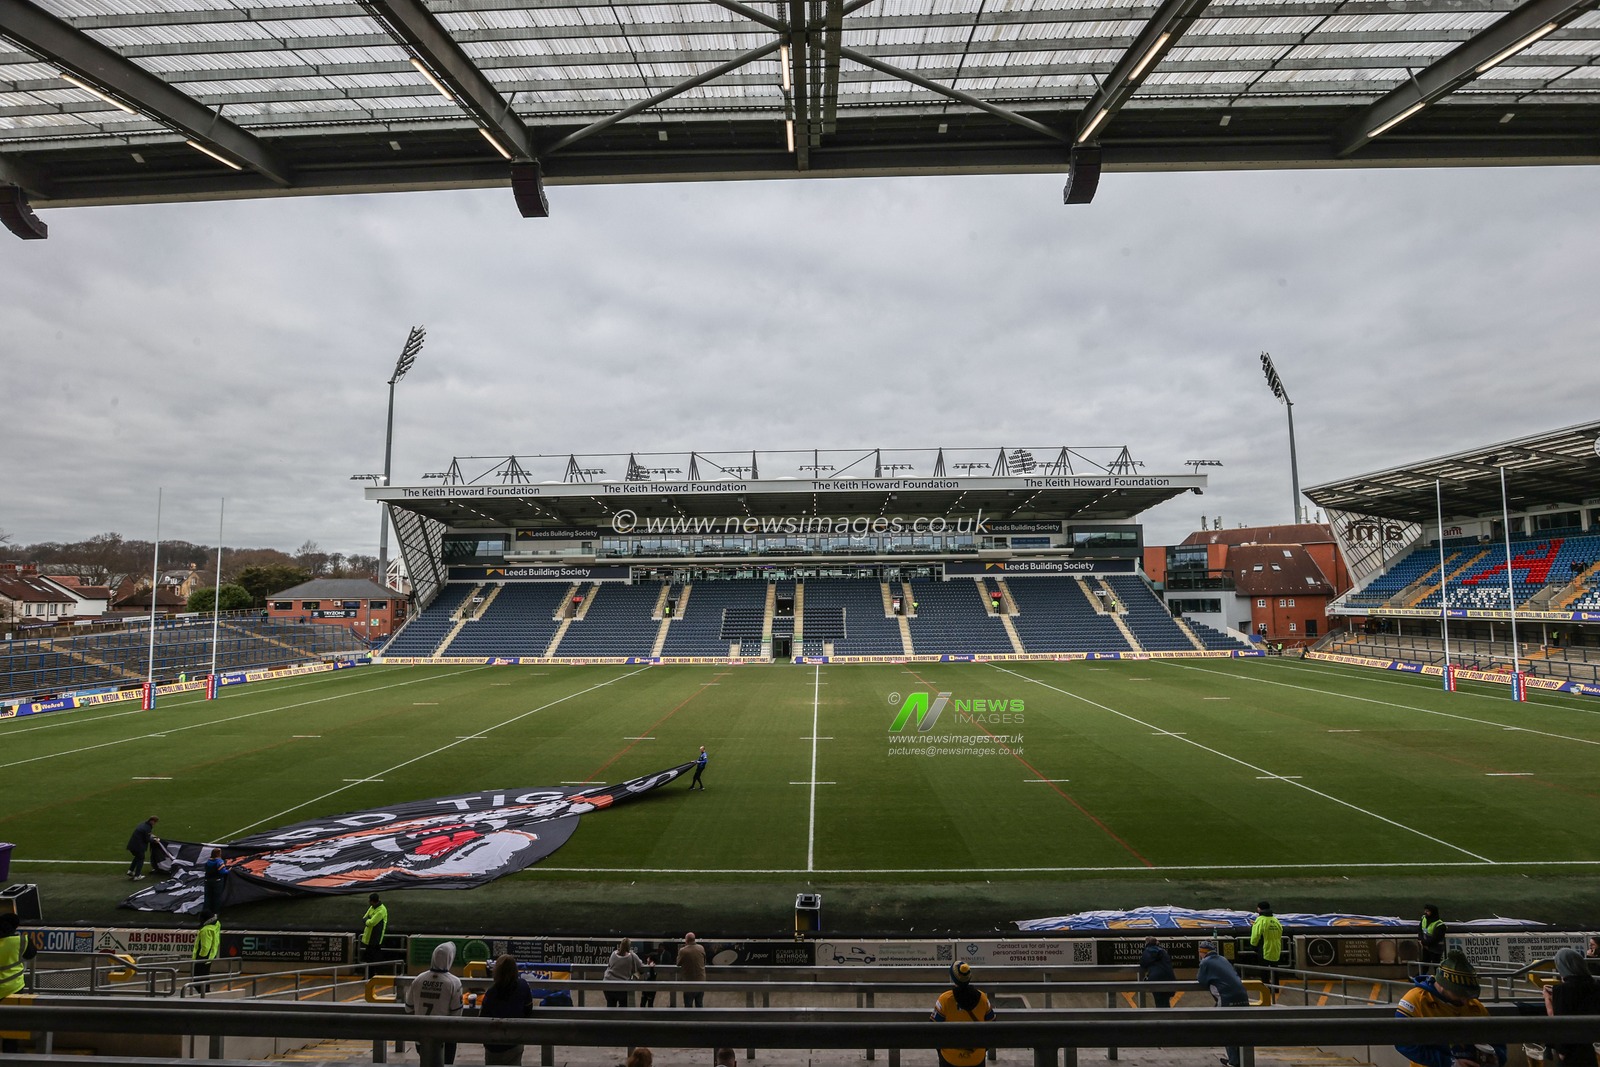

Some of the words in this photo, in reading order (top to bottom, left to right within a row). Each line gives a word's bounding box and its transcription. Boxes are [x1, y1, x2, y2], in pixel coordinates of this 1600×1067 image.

[812, 481, 830, 489] The
[834, 481, 858, 489] Keith
[862, 481, 900, 489] Howard
[903, 480, 959, 488] Foundation
[1024, 478, 1042, 487] The
[1045, 478, 1070, 487] Keith
[1074, 478, 1111, 486] Howard
[1115, 478, 1169, 486] Foundation
[402, 488, 419, 497] The
[421, 488, 445, 496] Keith
[448, 487, 484, 496] Howard
[487, 487, 540, 495] Foundation
[603, 485, 620, 493] The
[624, 484, 648, 493] Keith
[651, 484, 688, 492] Howard
[691, 483, 746, 491] Foundation
[1443, 526, 1462, 536] amt
[1005, 563, 1029, 571] Leeds
[1030, 563, 1062, 571] Building
[1064, 563, 1094, 571] Society
[504, 569, 527, 577] Leeds
[529, 569, 559, 577] Building
[561, 569, 591, 577] Society
[1484, 674, 1511, 683] CONTROLL
[102, 693, 119, 702] MEDIA
[122, 691, 134, 699] FREE
[129, 933, 141, 942] AB
[144, 933, 197, 943] CONSTRUC
[1465, 938, 1500, 946] INCLUSIVE
[544, 943, 555, 952] Get
[557, 943, 574, 954] Ryan
[576, 944, 583, 953] to
[584, 944, 598, 955] Buy
[600, 945, 615, 954] your
[1466, 947, 1498, 955] SECURITY
[423, 1003, 434, 1015] 7
